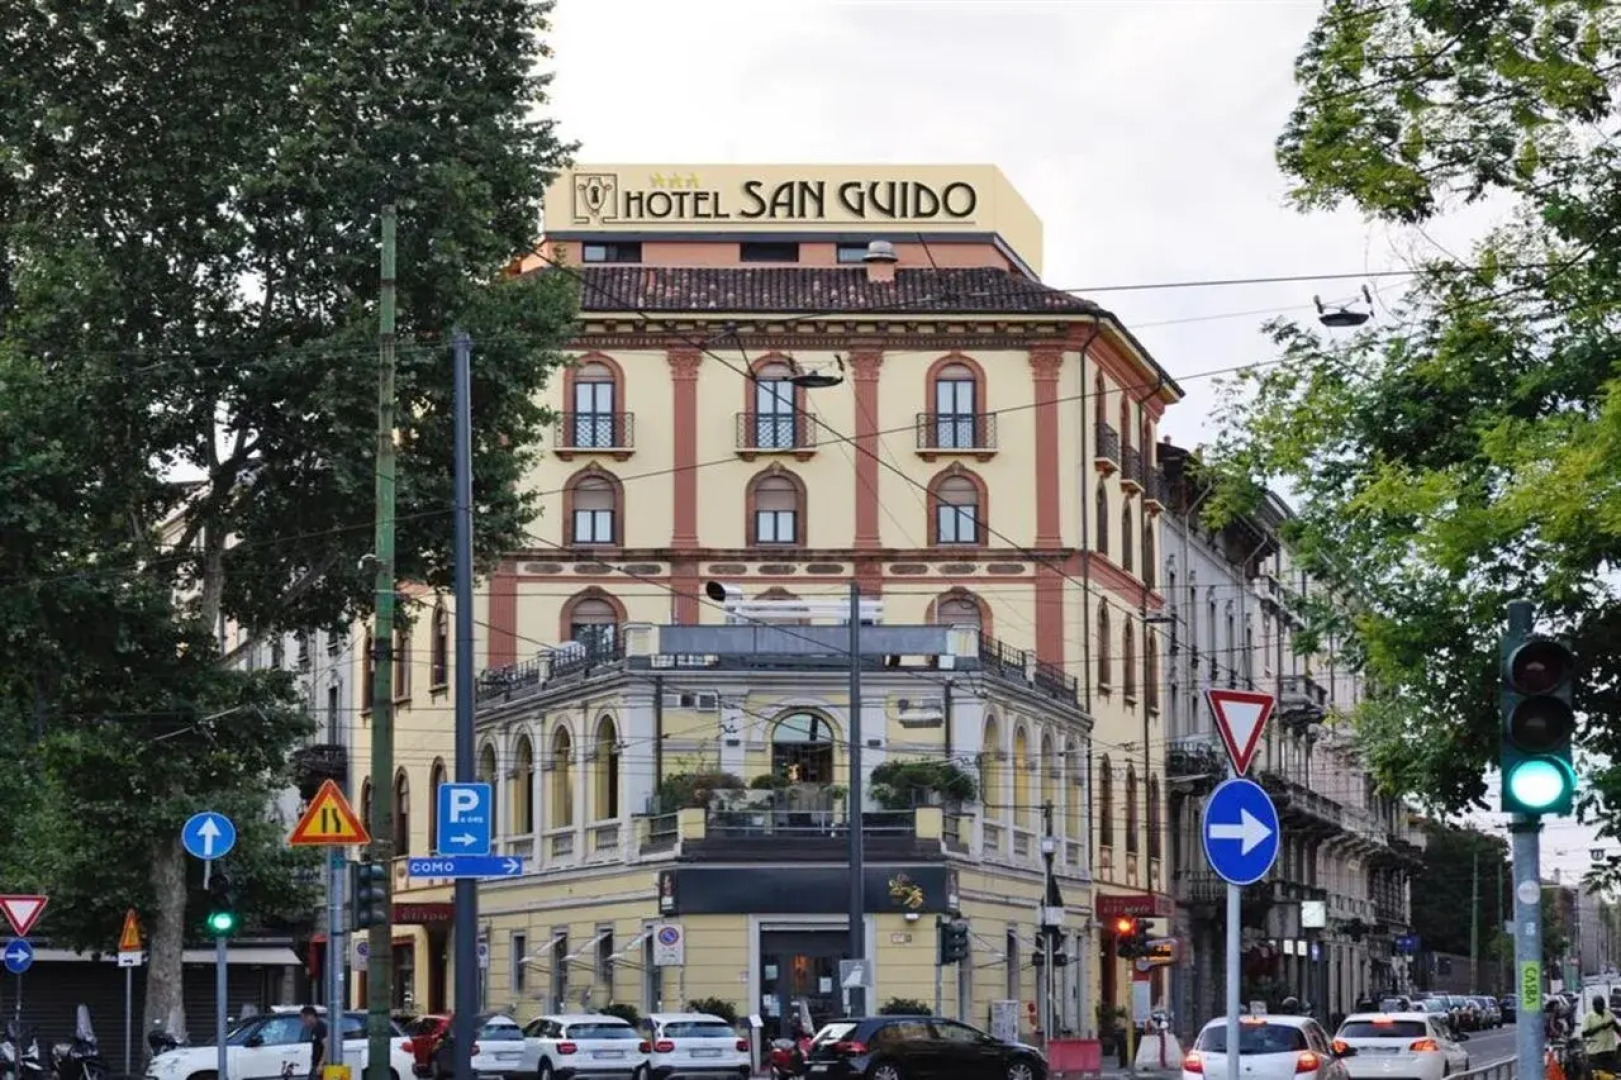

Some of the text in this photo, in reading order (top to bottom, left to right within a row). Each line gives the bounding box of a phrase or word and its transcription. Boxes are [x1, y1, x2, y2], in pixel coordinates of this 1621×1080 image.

[626, 181, 977, 219] HOTEL SAN GUIDO
[450, 788, 479, 823] P
[411, 861, 455, 873] COMO
